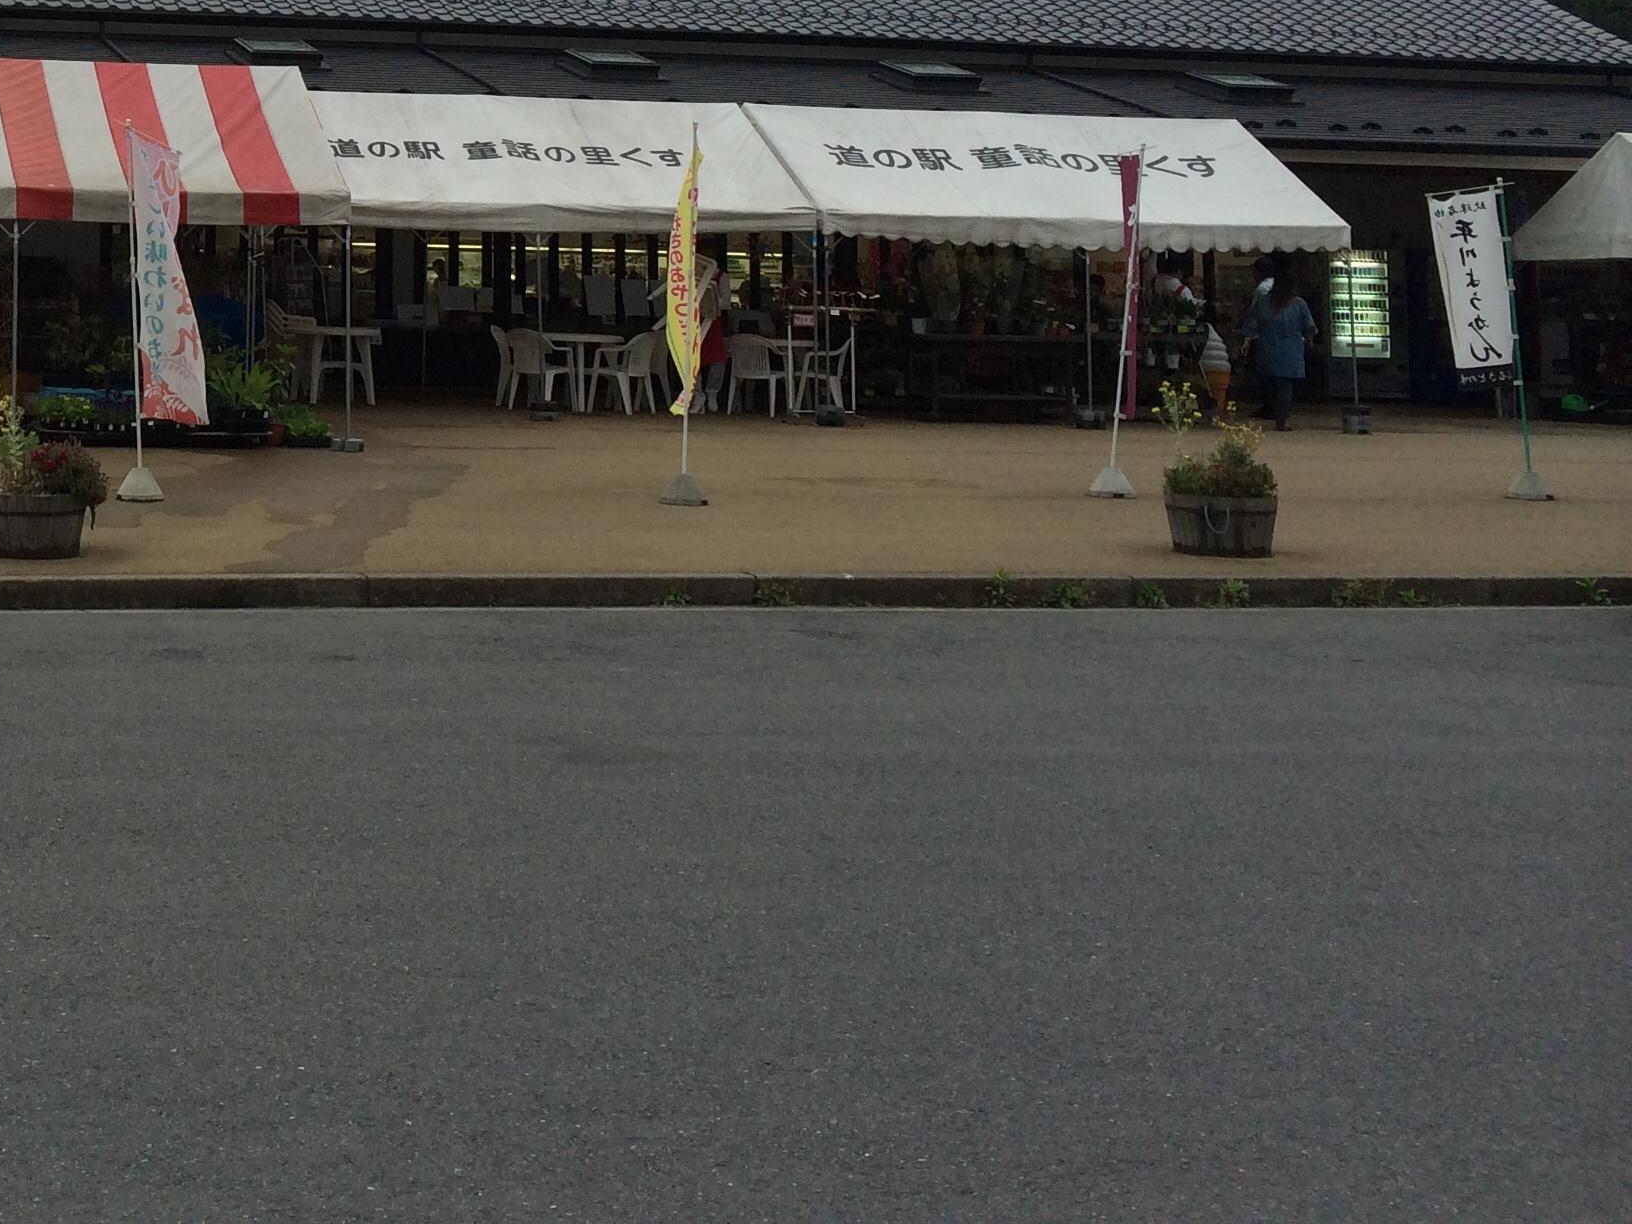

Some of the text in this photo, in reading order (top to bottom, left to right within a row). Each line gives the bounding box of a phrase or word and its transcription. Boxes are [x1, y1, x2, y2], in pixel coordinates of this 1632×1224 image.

[327, 138, 684, 168] 道の駅 童話の里くす
[824, 143, 963, 172] 道の駅
